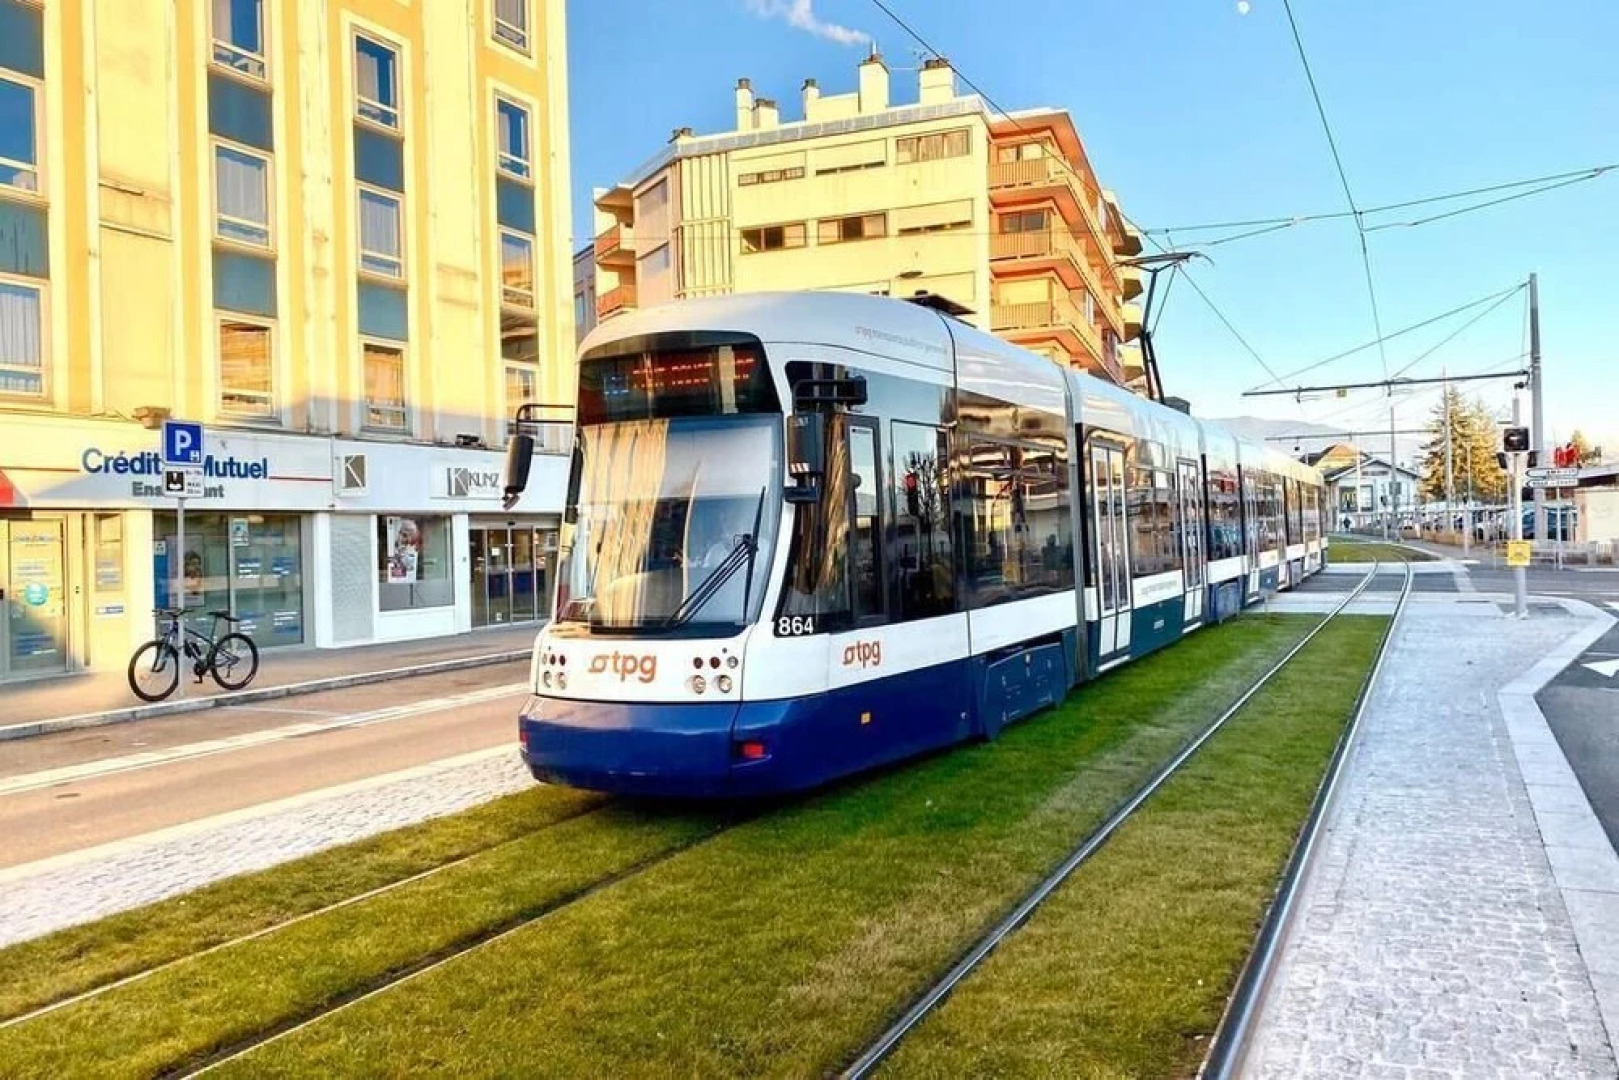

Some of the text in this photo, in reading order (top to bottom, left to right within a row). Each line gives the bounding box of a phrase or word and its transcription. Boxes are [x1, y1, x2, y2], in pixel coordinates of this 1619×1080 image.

[174, 429, 192, 456] P
[82, 448, 163, 475] Crédit
[778, 616, 814, 635] 864
[611, 650, 657, 683] tpg
[856, 640, 881, 669] tpg
